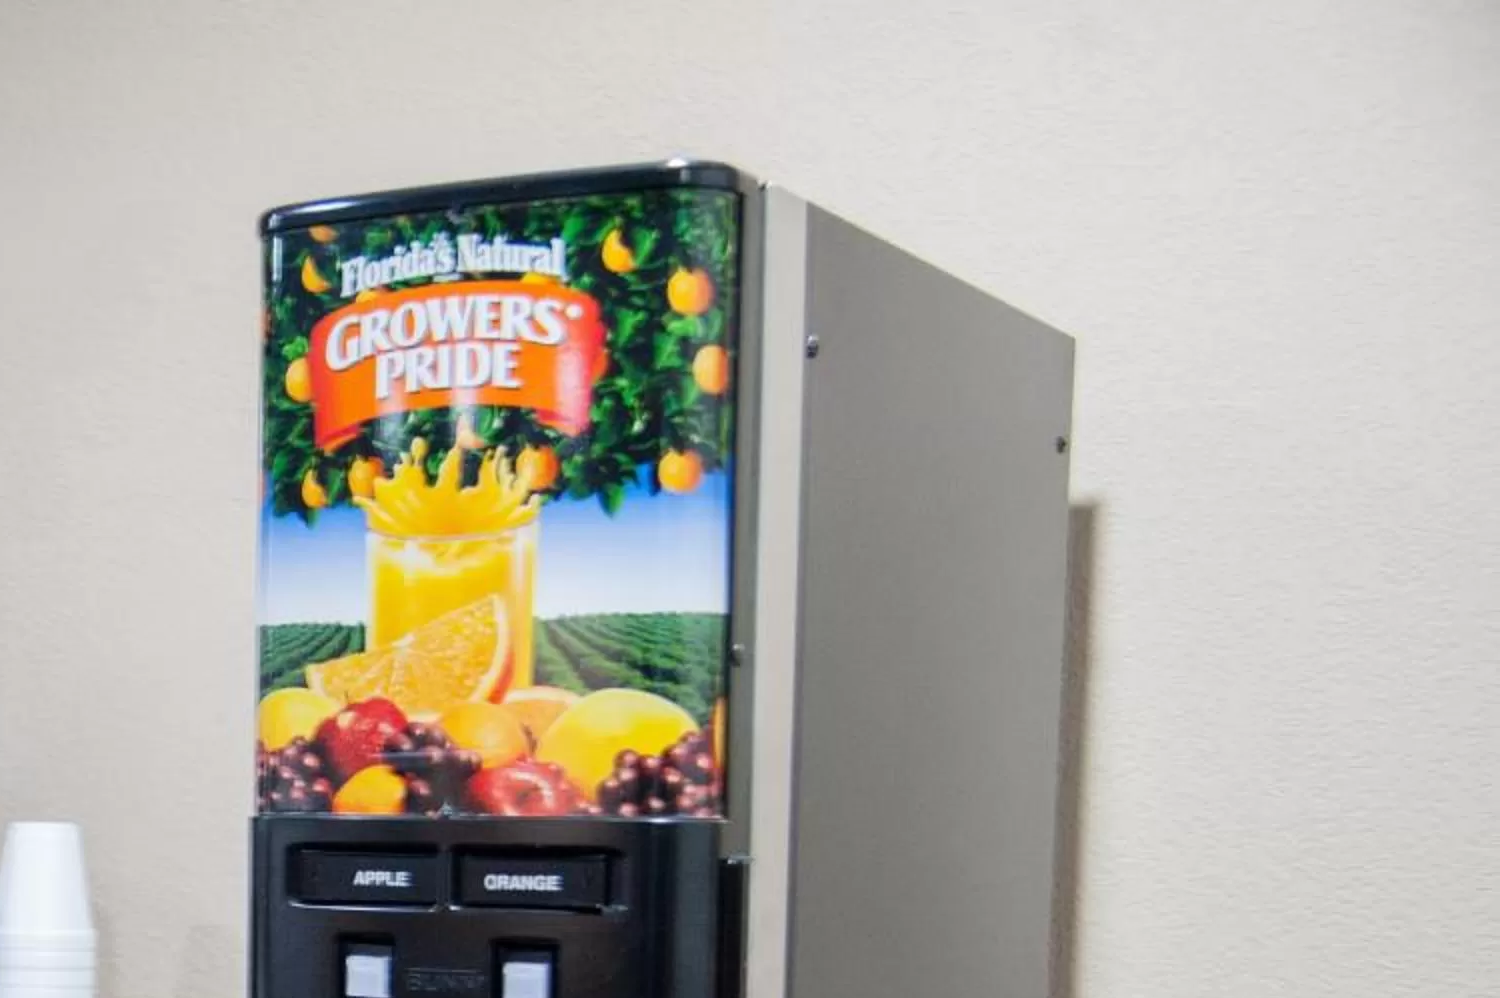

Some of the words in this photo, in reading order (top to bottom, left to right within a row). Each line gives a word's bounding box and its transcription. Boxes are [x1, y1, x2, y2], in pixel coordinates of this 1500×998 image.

[337, 233, 456, 298] Florida's
[457, 233, 568, 283] Natural
[375, 342, 524, 400] PRIDE
[353, 869, 413, 887] APPLE
[484, 873, 564, 892] ORANGE
